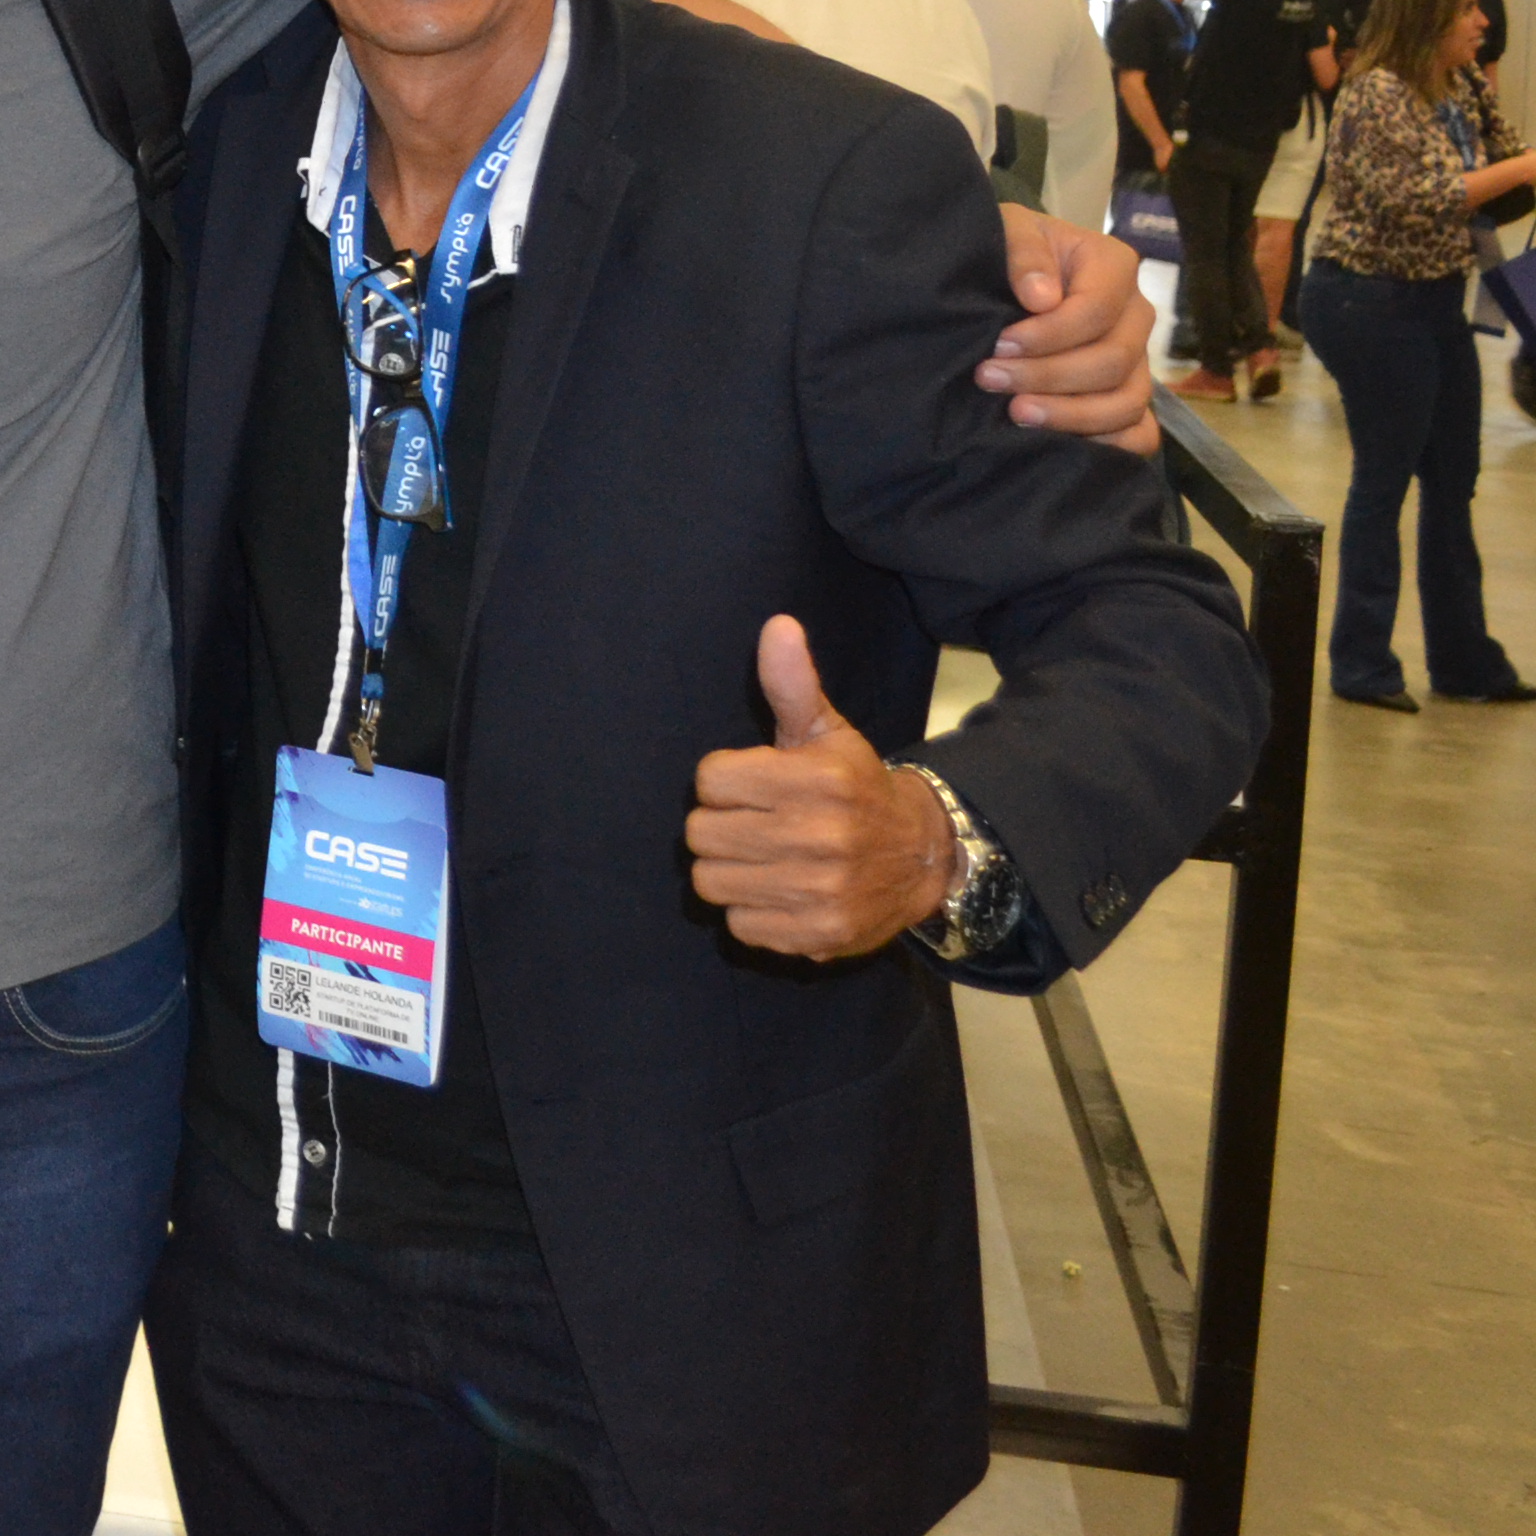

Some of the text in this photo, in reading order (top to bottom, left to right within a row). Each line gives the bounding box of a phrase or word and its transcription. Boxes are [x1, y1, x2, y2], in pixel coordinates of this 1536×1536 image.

[336, 194, 357, 276] CASE
[374, 554, 397, 638] CASE
[394, 435, 427, 527] ympla
[474, 116, 525, 190] CAS
[305, 829, 409, 881] CASE
[291, 918, 404, 961] PARTICIPANTE
[315, 975, 414, 1011] LELANDE HOLANDA
